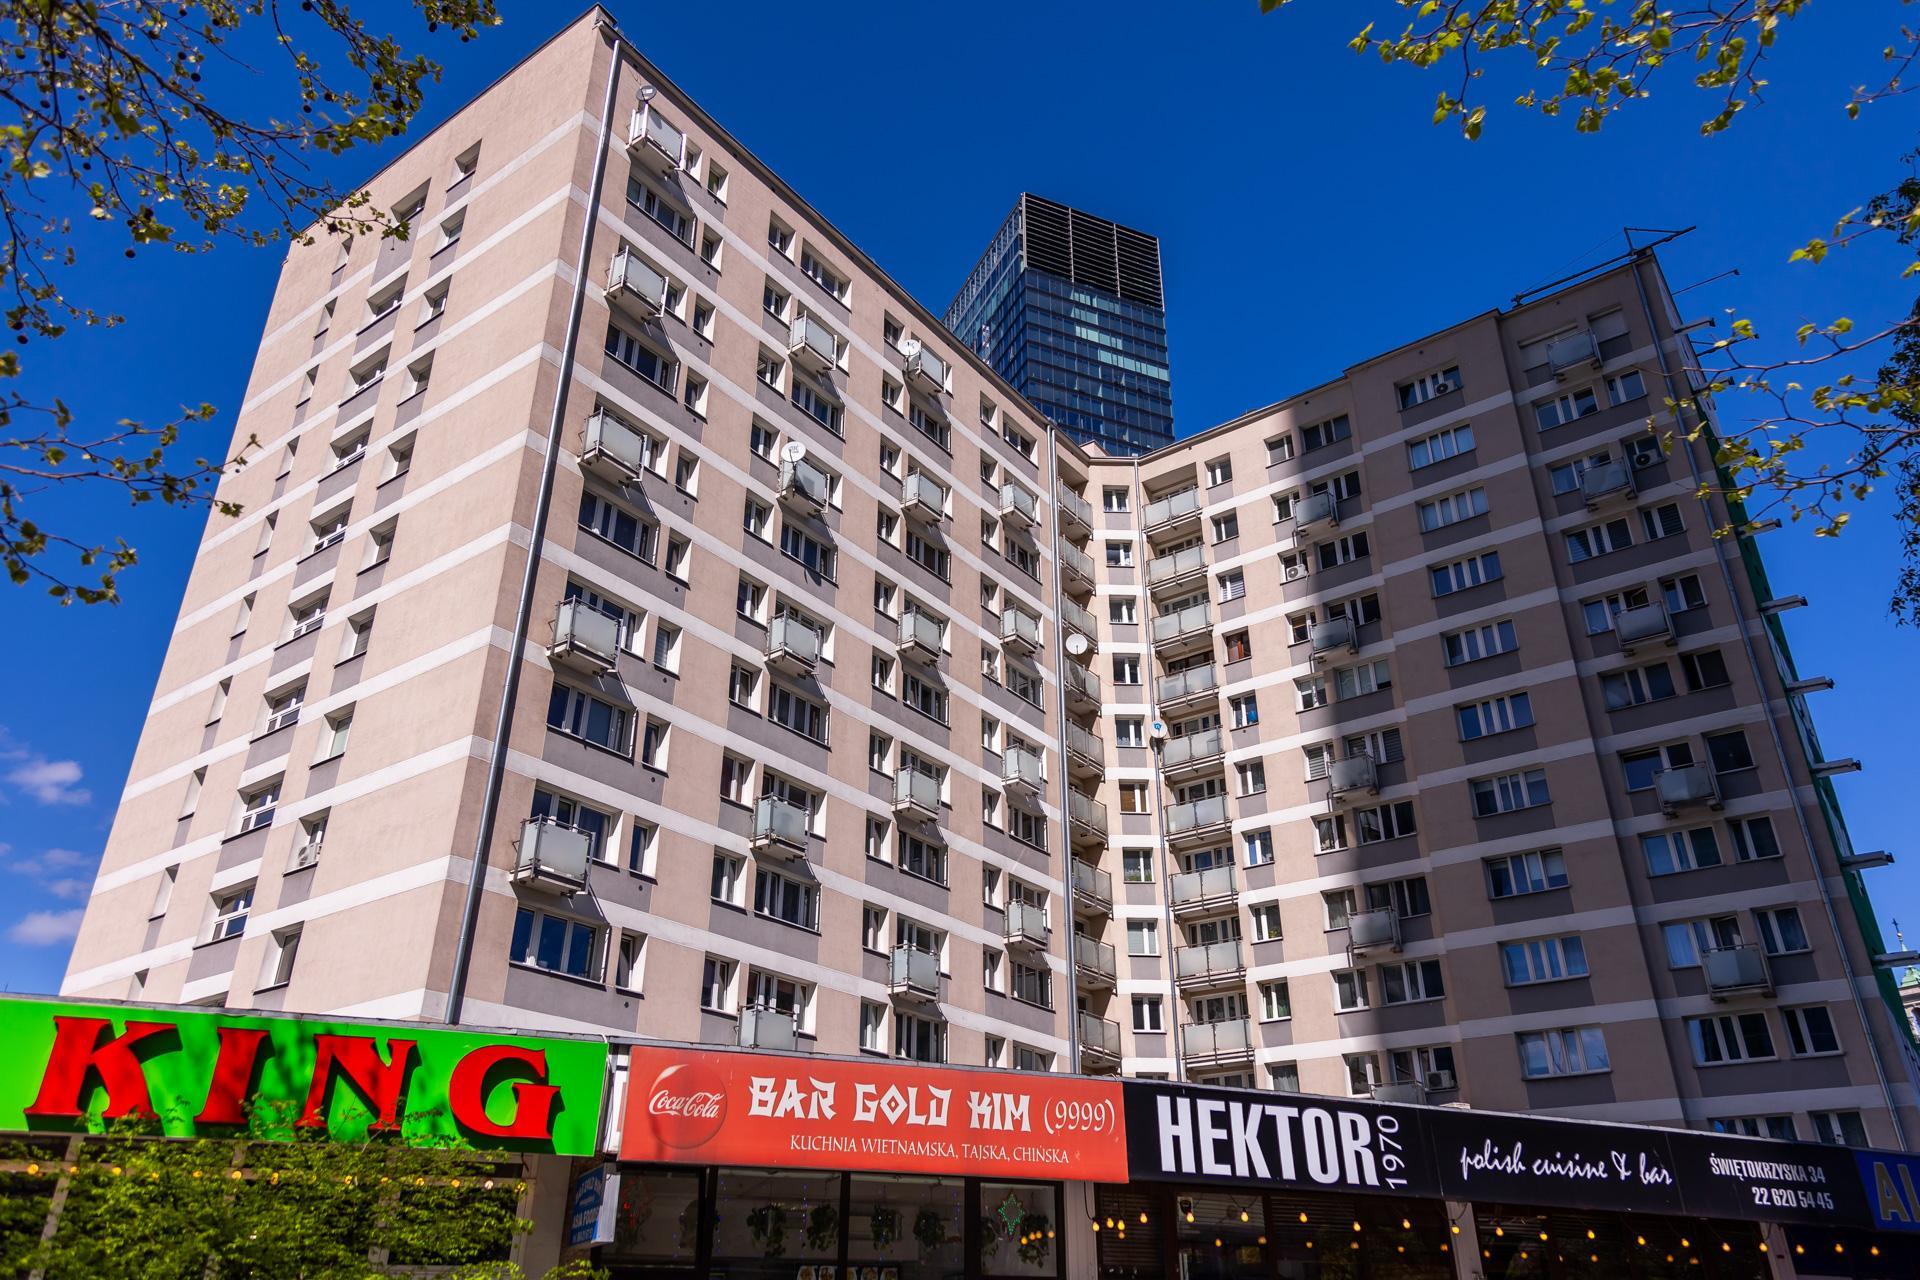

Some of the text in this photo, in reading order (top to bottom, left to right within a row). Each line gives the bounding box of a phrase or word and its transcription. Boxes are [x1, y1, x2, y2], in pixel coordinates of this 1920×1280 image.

[24, 1016, 560, 1139] KING
[649, 1090, 724, 1118] Coca-Cola
[748, 1075, 1115, 1135] BAR GOLD KIM (9999)
[790, 1134, 1069, 1163] KUCHNIA WIETNAMSKA, TAJSKA, CHIŃSKA
[1157, 1095, 1380, 1186] HEKTOR
[1376, 1115, 1407, 1189] 1970
[1460, 1138, 1672, 1185] polish cuisine & bar
[1709, 1153, 1826, 1183] ŚWIĘTOKRZYSKA 34
[1752, 1187, 1834, 1210] 22 620 54 45
